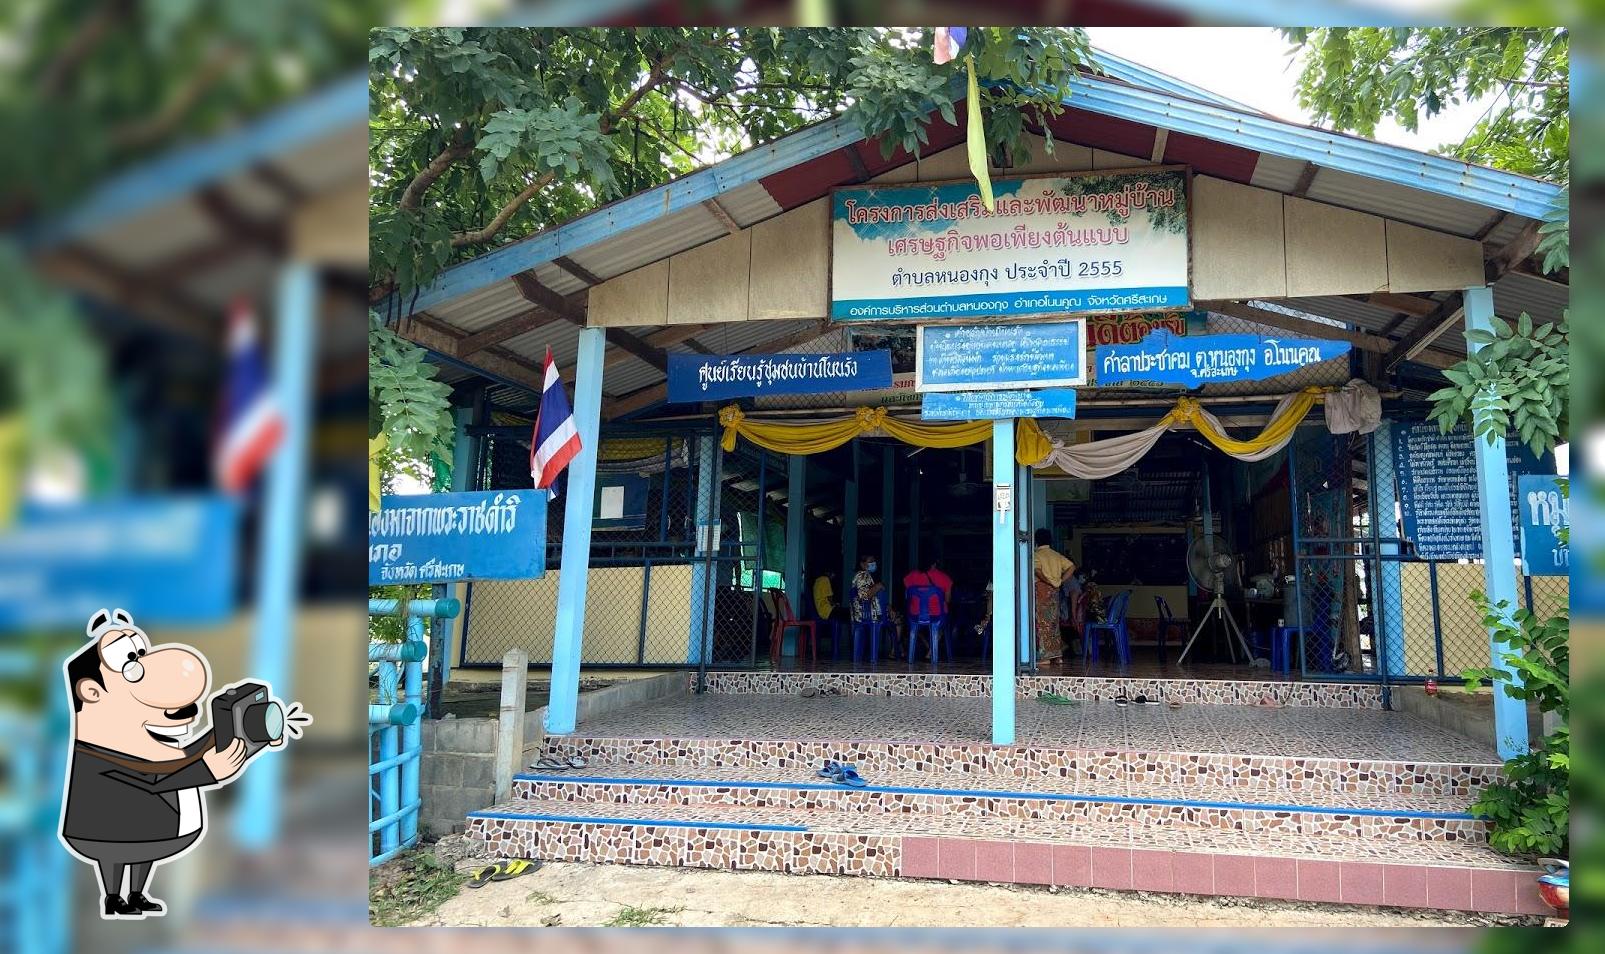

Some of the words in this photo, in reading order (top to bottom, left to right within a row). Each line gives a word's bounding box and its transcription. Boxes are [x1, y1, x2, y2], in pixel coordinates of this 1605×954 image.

[888, 222, 1129, 260] เศรษฐกิจพอเพียงต้นแบบ
[892, 267, 998, 286] ตำบลหนองกุง
[1005, 258, 1071, 280] ประจำปี
[1078, 260, 1123, 278] 2555
[850, 299, 1009, 316] องค์การบริหารส่วนตำบลหนองกุง
[1014, 295, 1082, 311] อำเภอโนนคูณ
[1087, 293, 1168, 308] จังหวัดศรีสะเกษ
[699, 356, 858, 391] ศูนย์เรียนรู้ชุมชนบ้านโนนรัง
[1103, 347, 1190, 374] ศาลาประชาคม
[1196, 347, 1256, 373] ต.หนองกุง
[1264, 339, 1321, 366] อ.โนนคูณ
[369, 493, 521, 537] องมาจากพระราชดำริ
[381, 561, 418, 580] จังหวัด
[419, 557, 465, 579] ศรีสะเกษ
